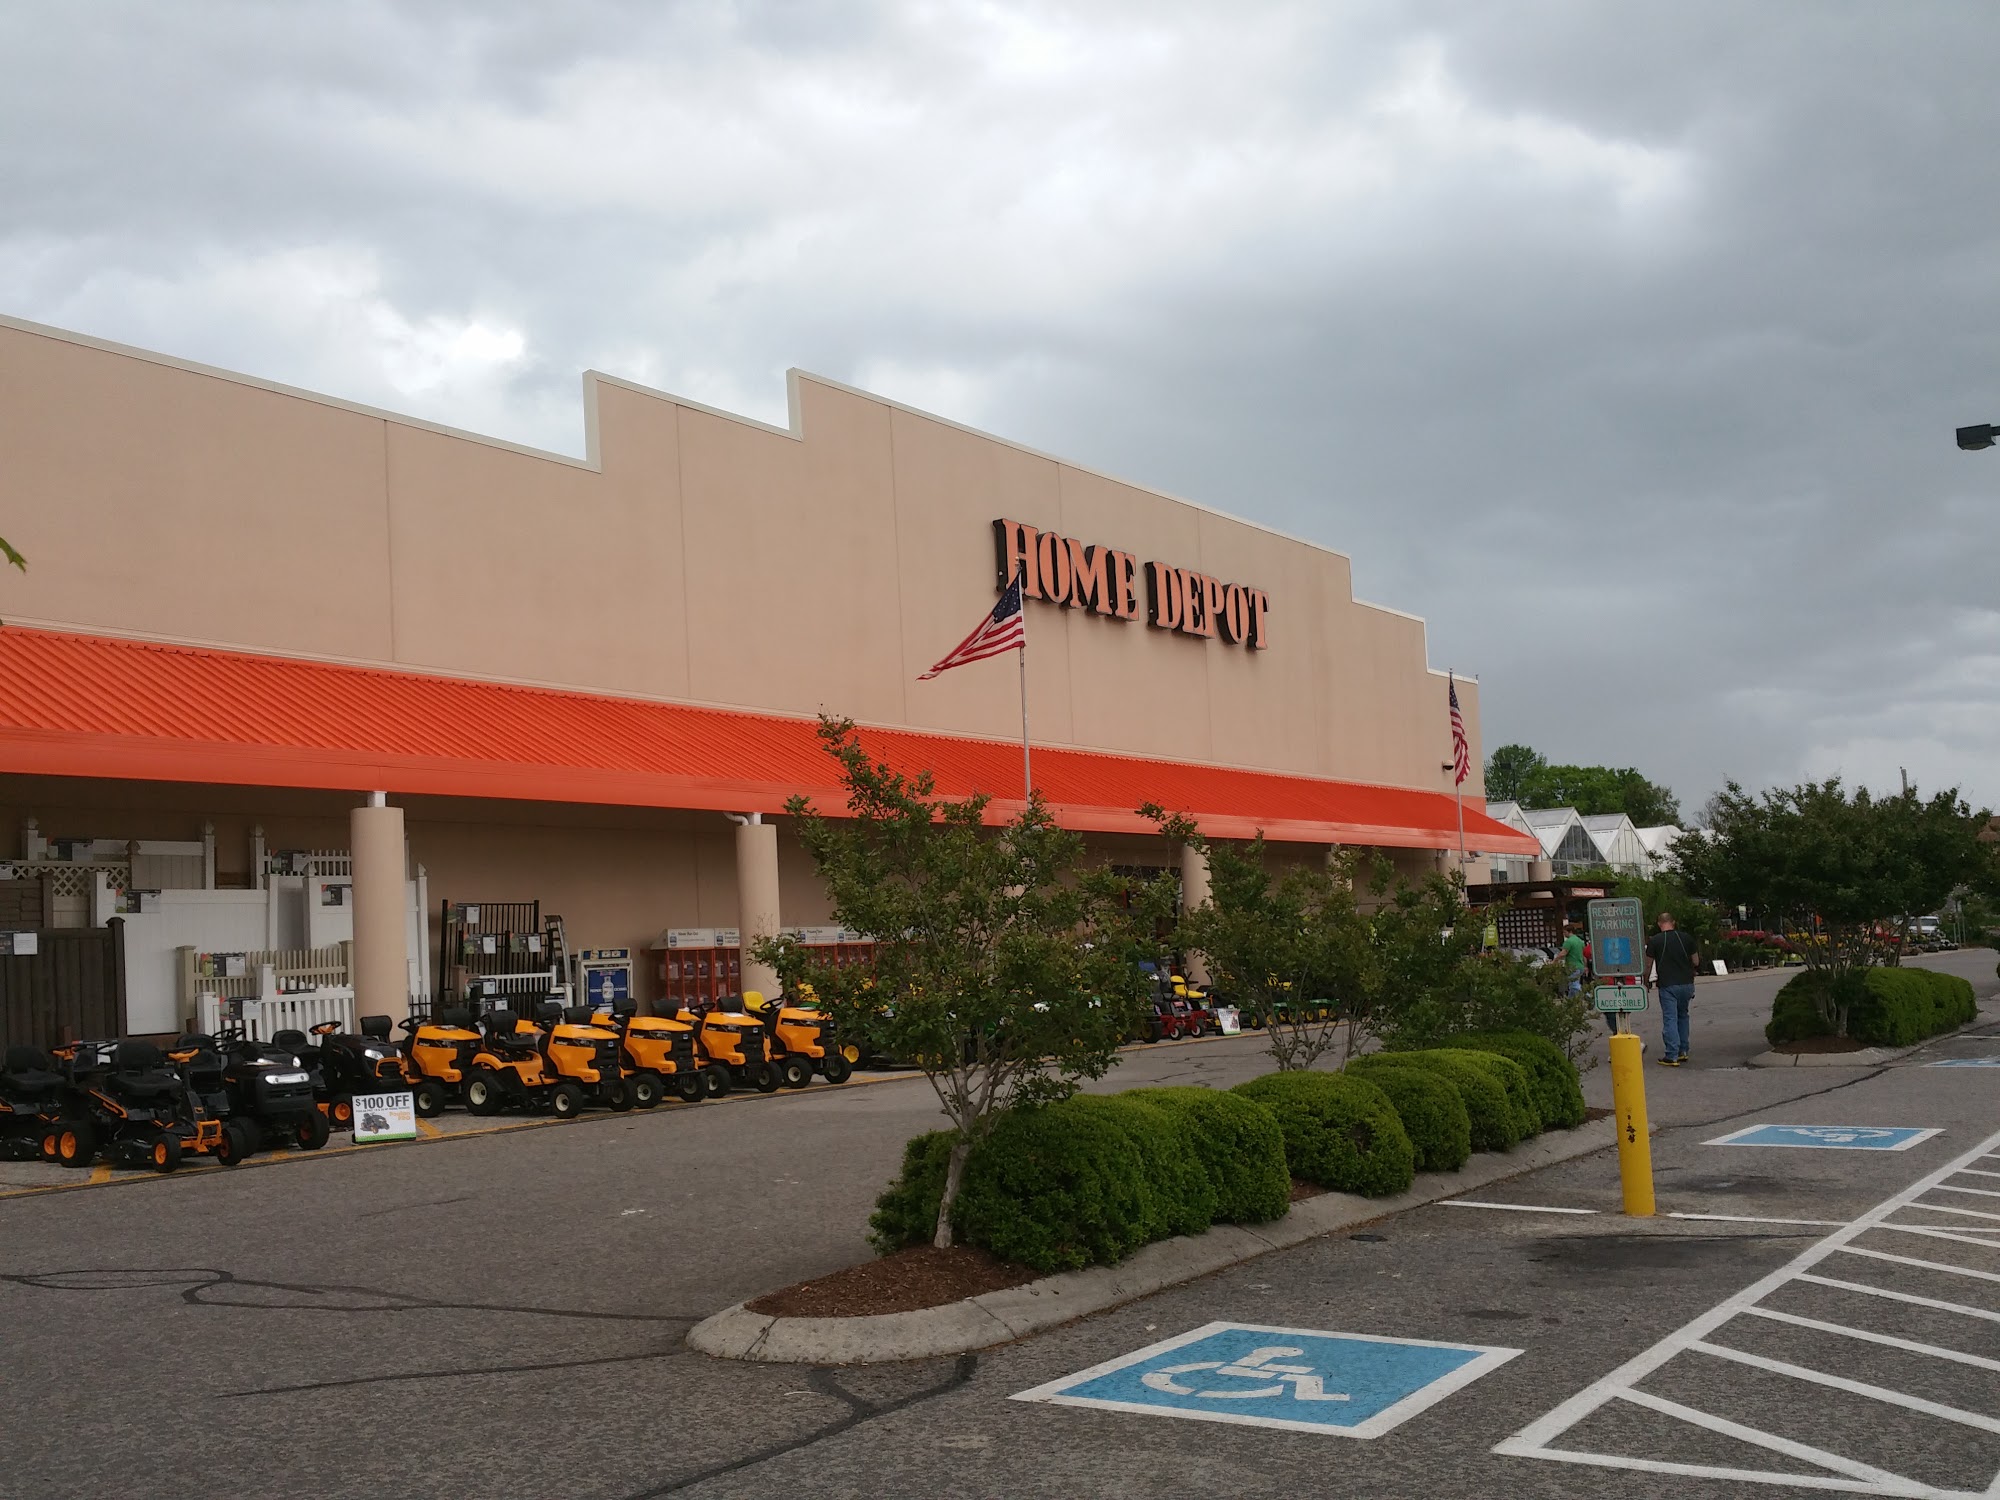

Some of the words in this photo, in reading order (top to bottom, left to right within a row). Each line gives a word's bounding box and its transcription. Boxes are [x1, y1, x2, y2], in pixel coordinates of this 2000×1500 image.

[993, 518, 1139, 621] HOME
[1145, 561, 1270, 649] DEPOT
[1592, 905, 1636, 917] RESERVED
[1595, 918, 1634, 929] PARKING
[1613, 990, 1627, 998] VAN
[1600, 999, 1642, 1007] ACCESSIBLE
[355, 1097, 384, 1109] $100
[386, 1095, 410, 1107] OFF
